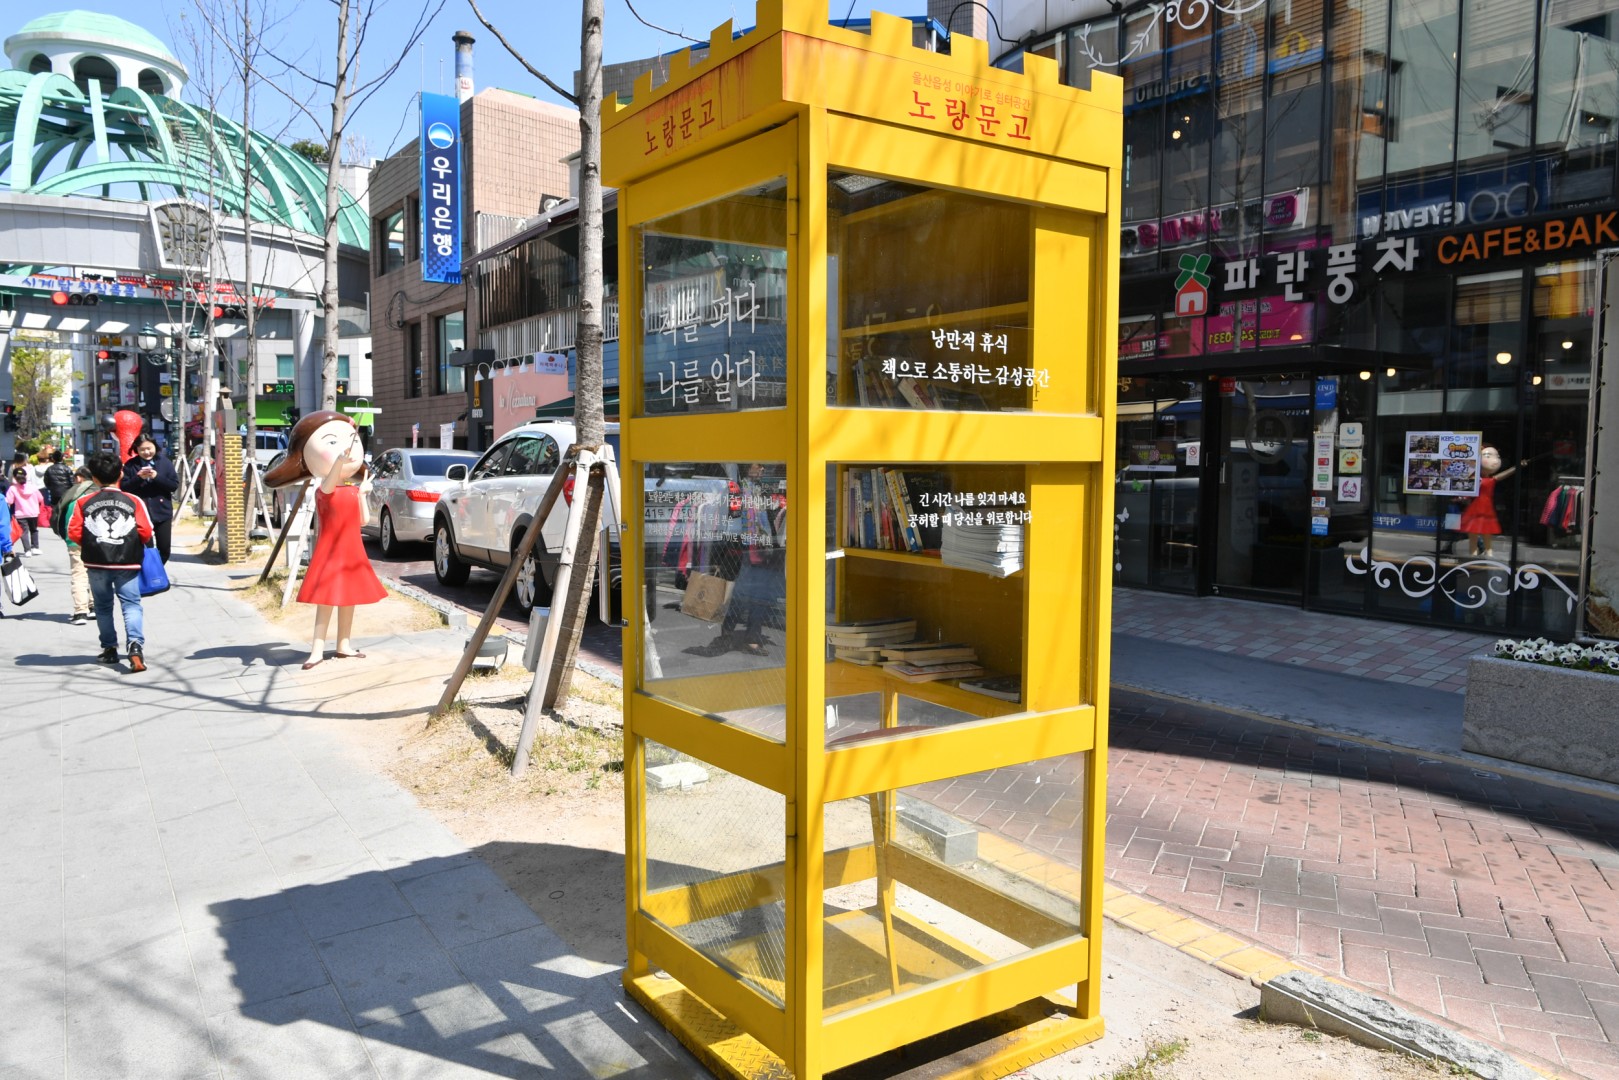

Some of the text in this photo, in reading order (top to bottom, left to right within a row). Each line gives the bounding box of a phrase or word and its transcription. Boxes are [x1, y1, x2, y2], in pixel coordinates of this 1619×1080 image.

[912, 71, 951, 93] 울산읍성
[955, 82, 992, 101] 이야기로
[644, 99, 716, 156] 노랑문고
[908, 90, 1031, 141] 노랑문고
[431, 155, 453, 256] 우리은행
[1437, 210, 1619, 266] CAFE&BAK
[1223, 236, 1419, 304] 파란풍차
[658, 282, 760, 346] 책을 펴다
[931, 328, 1008, 355] 낭만적 휴식
[658, 350, 761, 407] 나를 알다
[881, 357, 1050, 388] 책으로 소통하는 감성공간
[644, 507, 665, 519] 41두
[908, 510, 1033, 528] 공허할 때 당신을 위로합니다
[919, 491, 1027, 508] 긴 시간 나를 잊지 마세요
